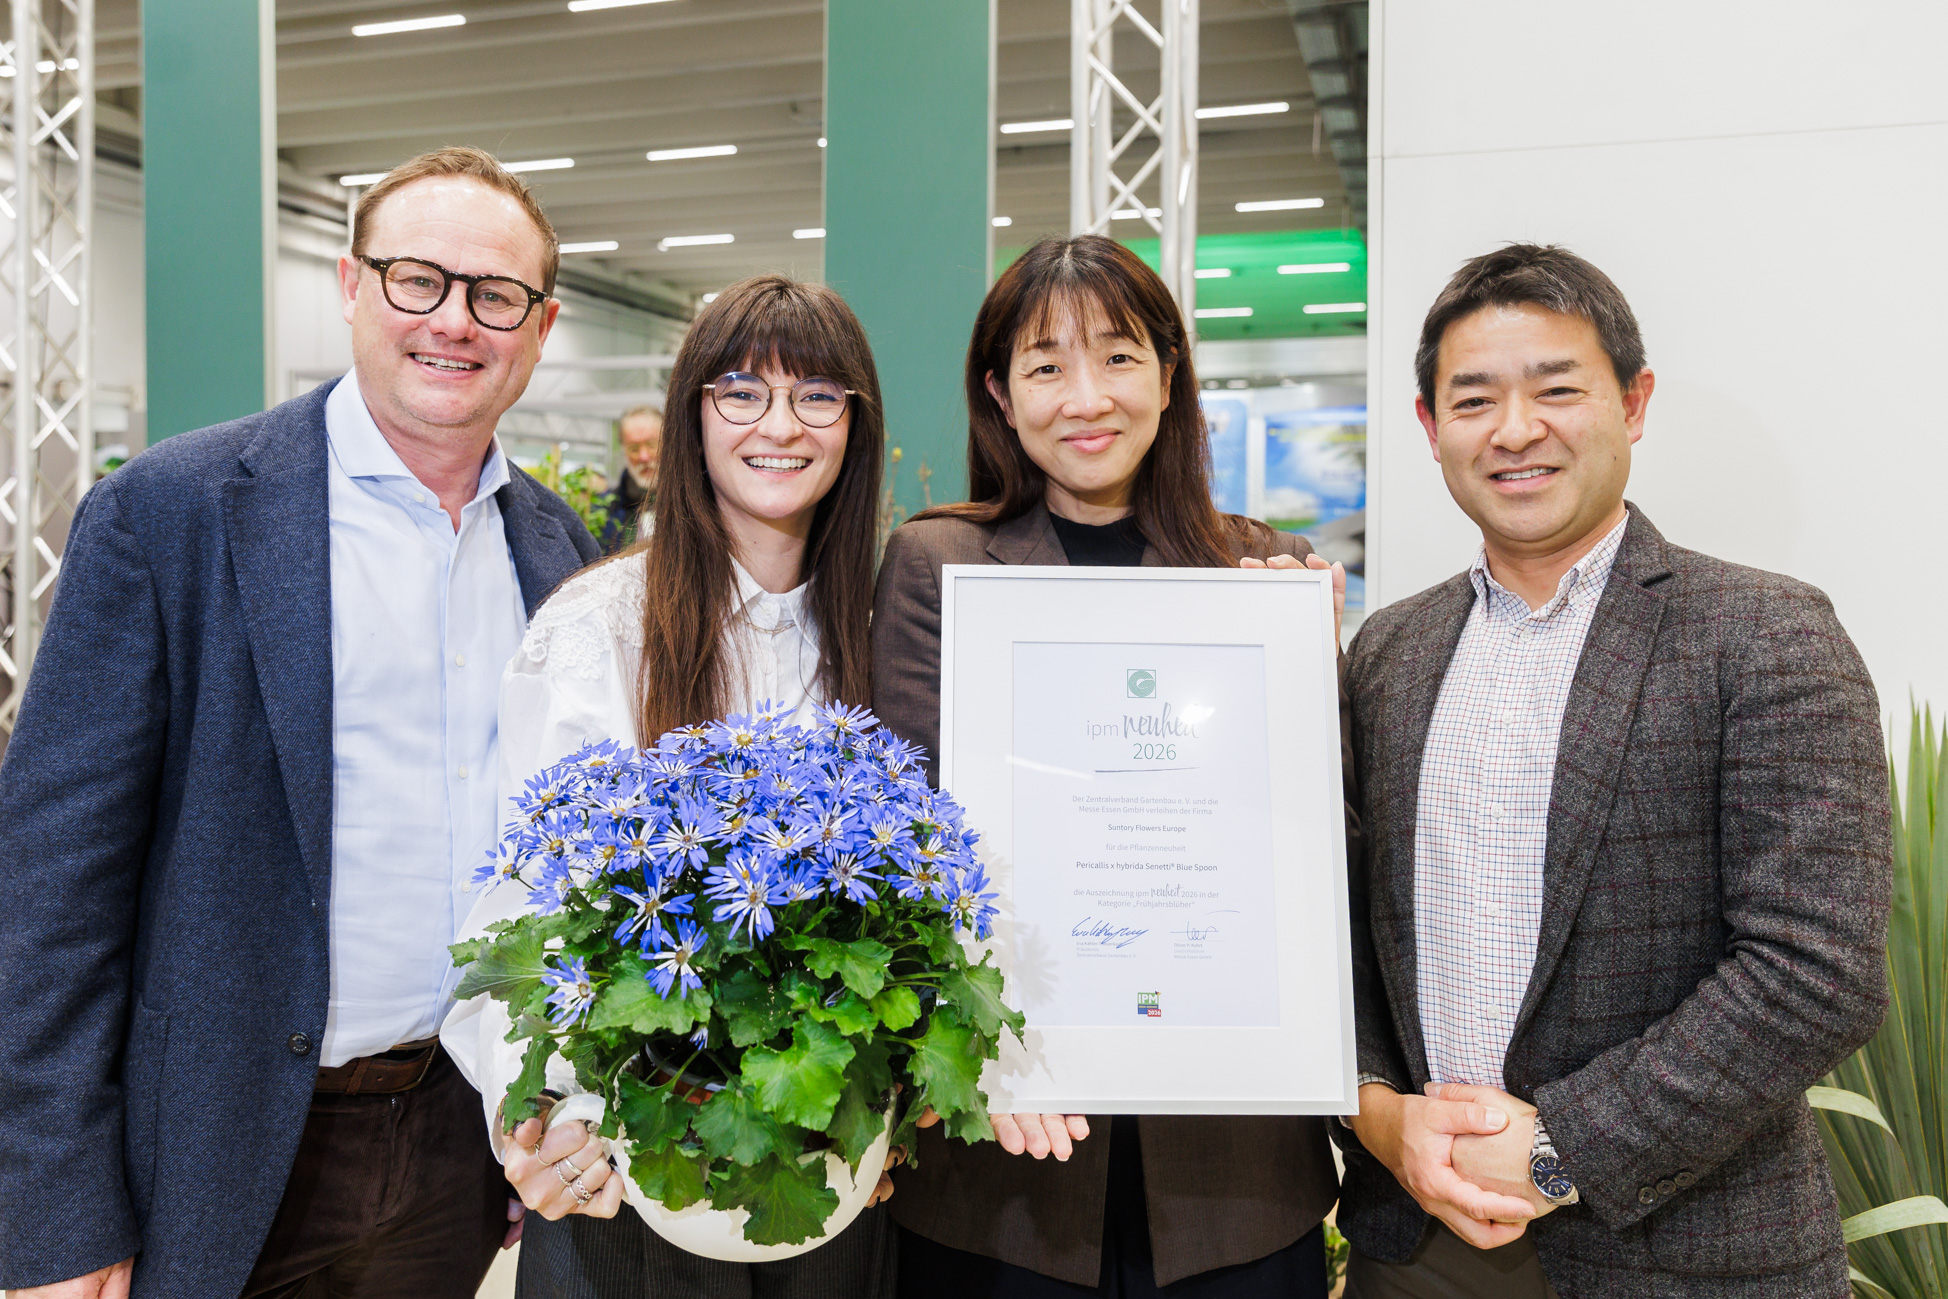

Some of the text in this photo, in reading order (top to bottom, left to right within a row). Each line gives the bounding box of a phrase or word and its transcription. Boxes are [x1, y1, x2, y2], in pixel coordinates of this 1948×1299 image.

[1086, 720, 1119, 740] ipm
[1133, 742, 1177, 761] 2026
[1072, 795, 1084, 803] Der
[1085, 795, 1139, 804] Zentralverband
[1140, 796, 1177, 804] Gartenbau
[1192, 797, 1206, 805] und
[1207, 797, 1219, 805] die
[1079, 805, 1213, 815] Messe Essen GmbH verleihen der Firma
[1107, 823, 1187, 833] Suntory Flowers Europe
[1105, 843, 1186, 852] für die Pflanzenneuheit
[1076, 861, 1109, 870] Pericallis
[1116, 862, 1144, 871] hybrida
[1176, 863, 1193, 871] Blue
[1194, 864, 1218, 872] Spoon
[1073, 888, 1085, 896] die
[1085, 889, 1135, 898] Auszeichnung
[1135, 889, 1150, 898] ipm
[1181, 890, 1198, 898] 2026
[1199, 890, 1207, 898] in
[1207, 890, 1220, 898] der
[1097, 899, 1131, 908] Kategorie
[1138, 993, 1158, 1004] IPM
